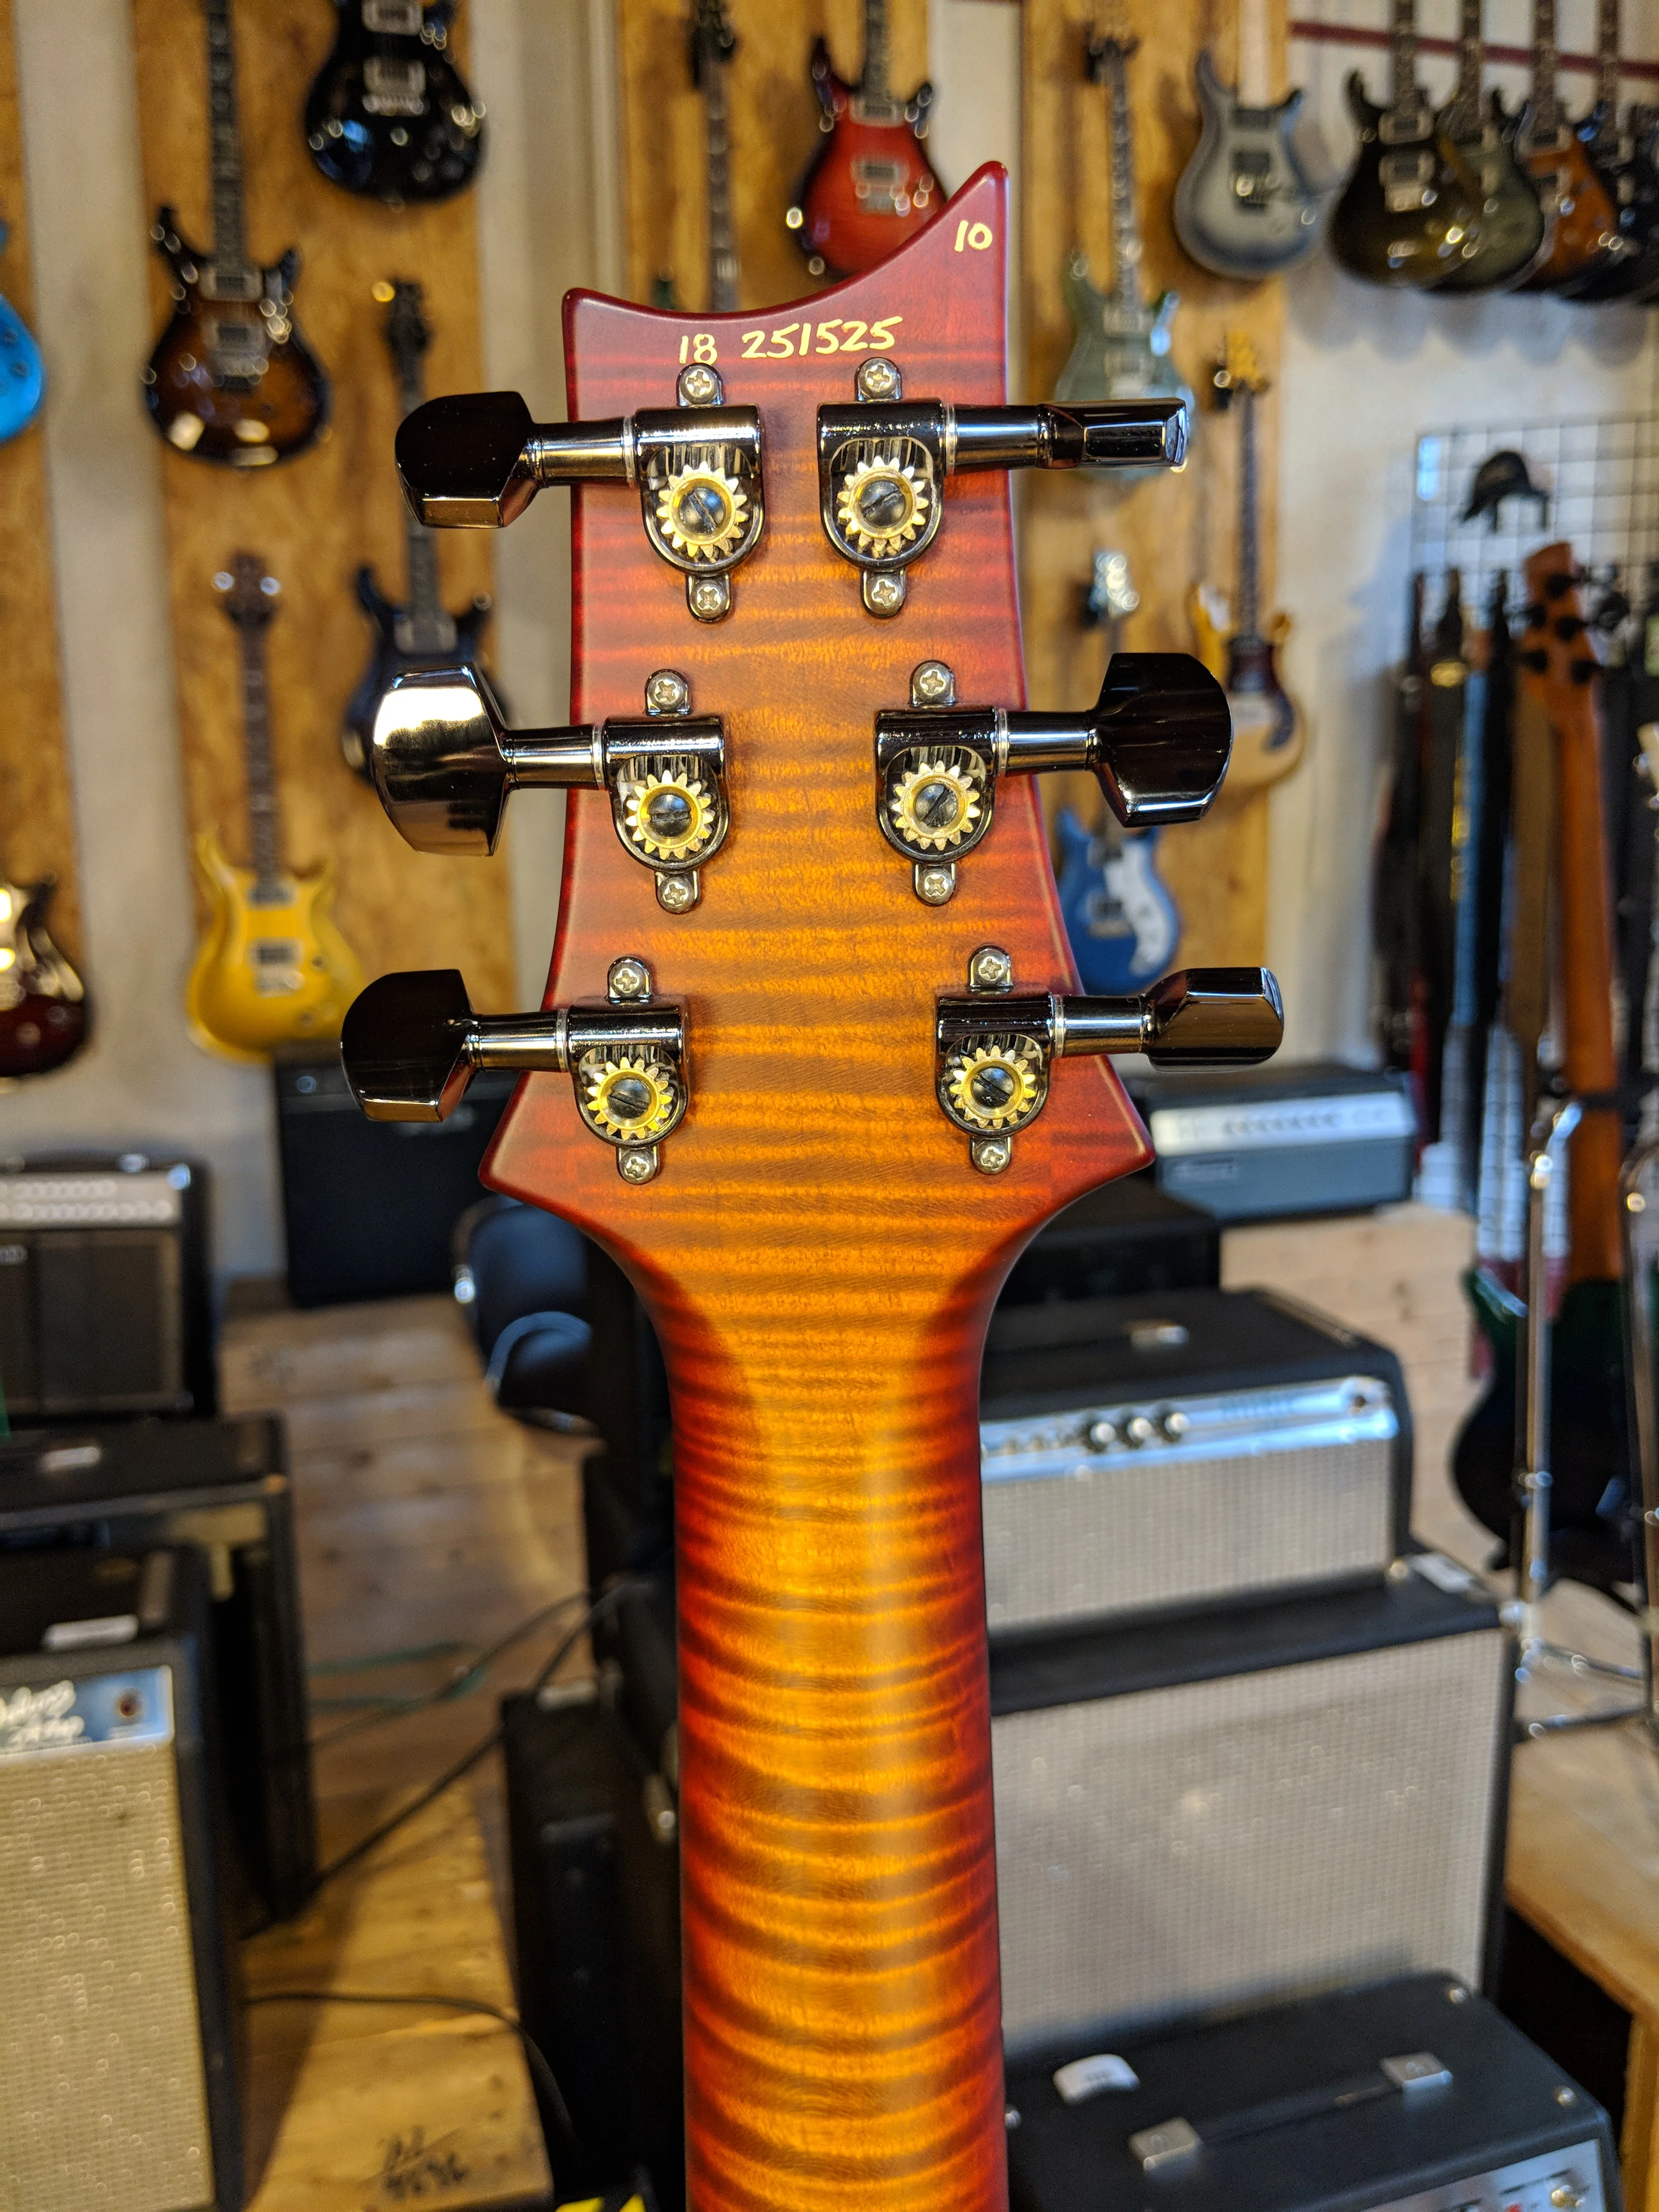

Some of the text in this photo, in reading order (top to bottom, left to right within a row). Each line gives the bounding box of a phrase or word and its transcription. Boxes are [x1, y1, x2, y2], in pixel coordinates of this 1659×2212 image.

[954, 219, 993, 252] 10
[679, 315, 903, 366] 18 251525
